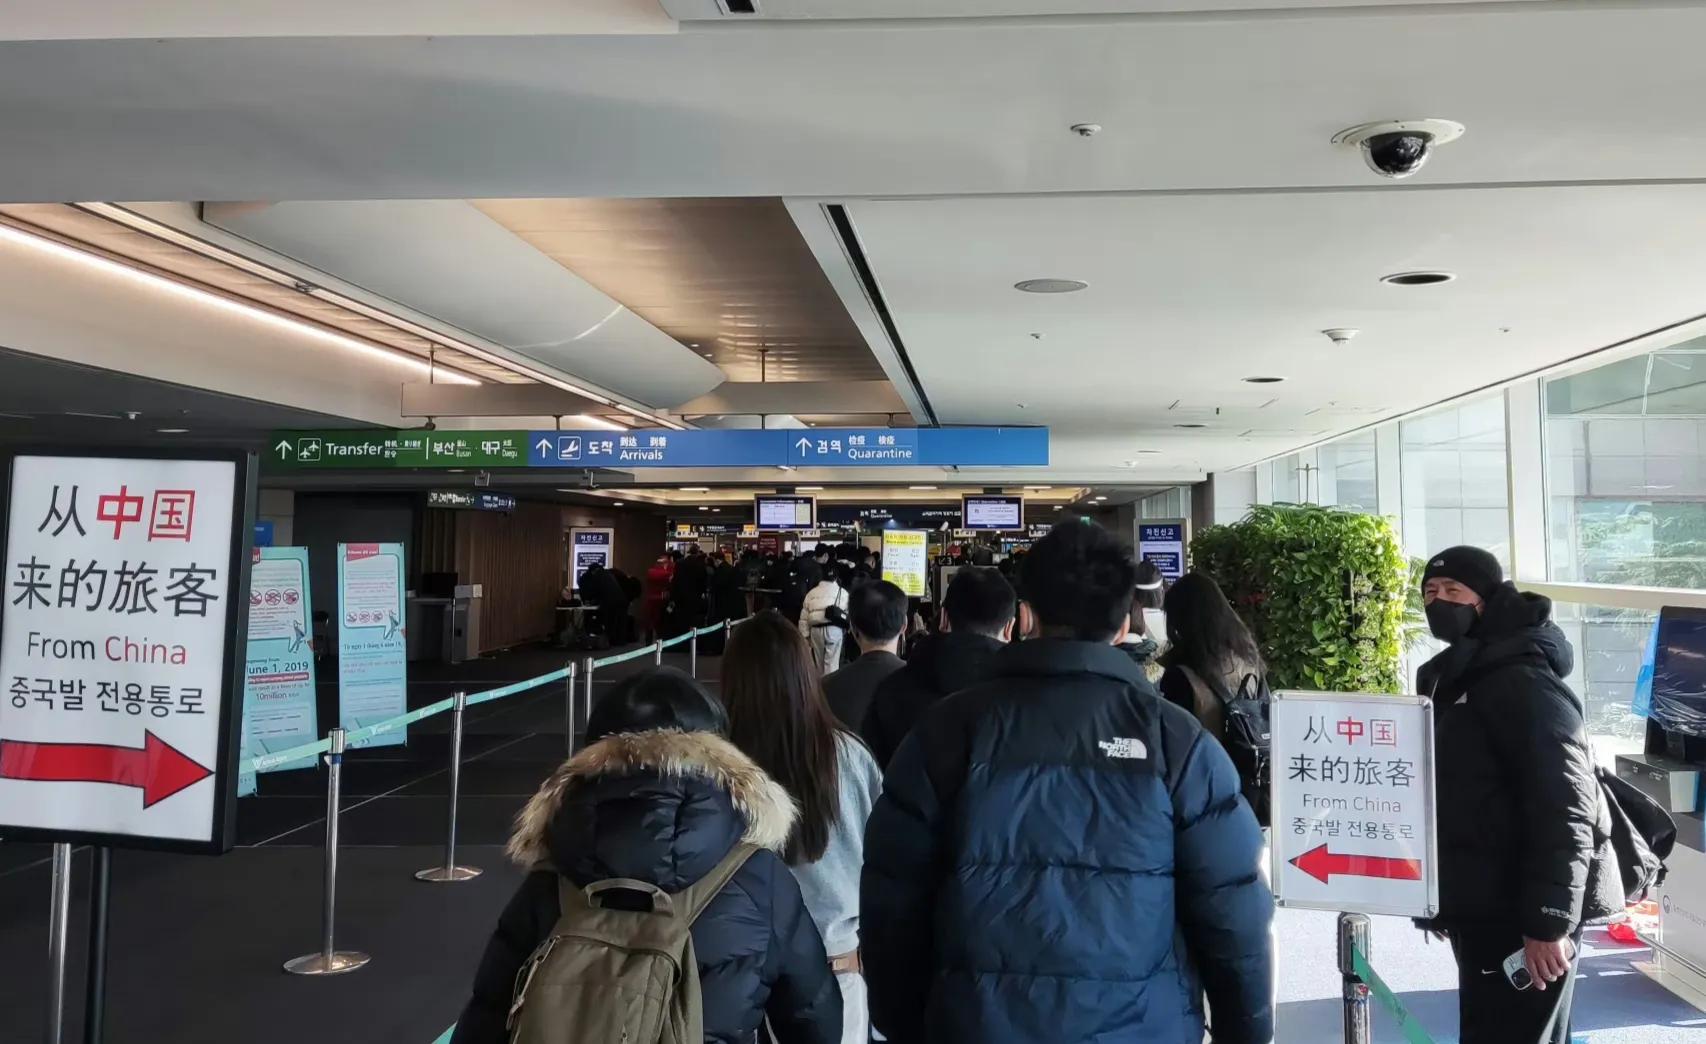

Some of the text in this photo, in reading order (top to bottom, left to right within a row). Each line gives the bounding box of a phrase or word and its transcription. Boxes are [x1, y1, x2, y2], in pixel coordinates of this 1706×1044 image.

[325, 441, 383, 456] Transfer
[433, 441, 455, 455] 부산
[481, 440, 500, 455] 대구
[588, 440, 614, 455] 도착
[620, 449, 663, 460] Arrivals
[817, 439, 842, 454] 검역
[847, 447, 913, 460] Quarantine
[37, 484, 196, 543] 从中国
[12, 555, 220, 617] 来的旅客
[28, 631, 187, 666] From China
[284, 660, 309, 672] 2019
[8, 675, 87, 712] 중국발
[96, 680, 206, 718] 전용통로
[1303, 716, 1397, 747] 从中国
[1288, 753, 1415, 787] 来的旅客
[1303, 793, 1401, 814] From China
[1292, 817, 1415, 841] 중국발 전용통로
